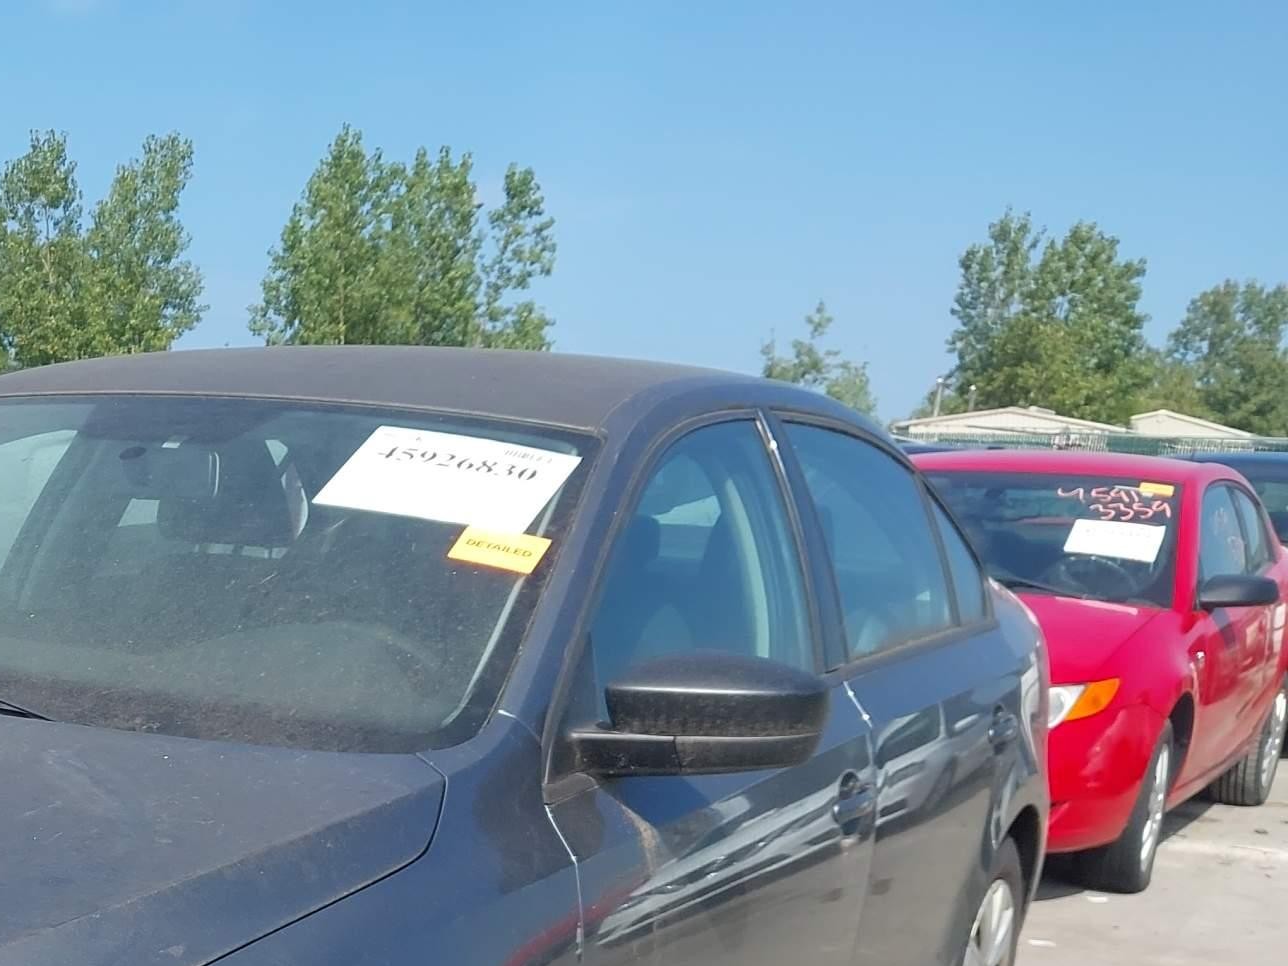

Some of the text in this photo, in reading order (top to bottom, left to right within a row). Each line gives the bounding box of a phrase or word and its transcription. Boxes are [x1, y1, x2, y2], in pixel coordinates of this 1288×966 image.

[378, 446, 538, 480] 45926830
[1088, 500, 1172, 521] 3359
[465, 538, 533, 558] DETAILED
